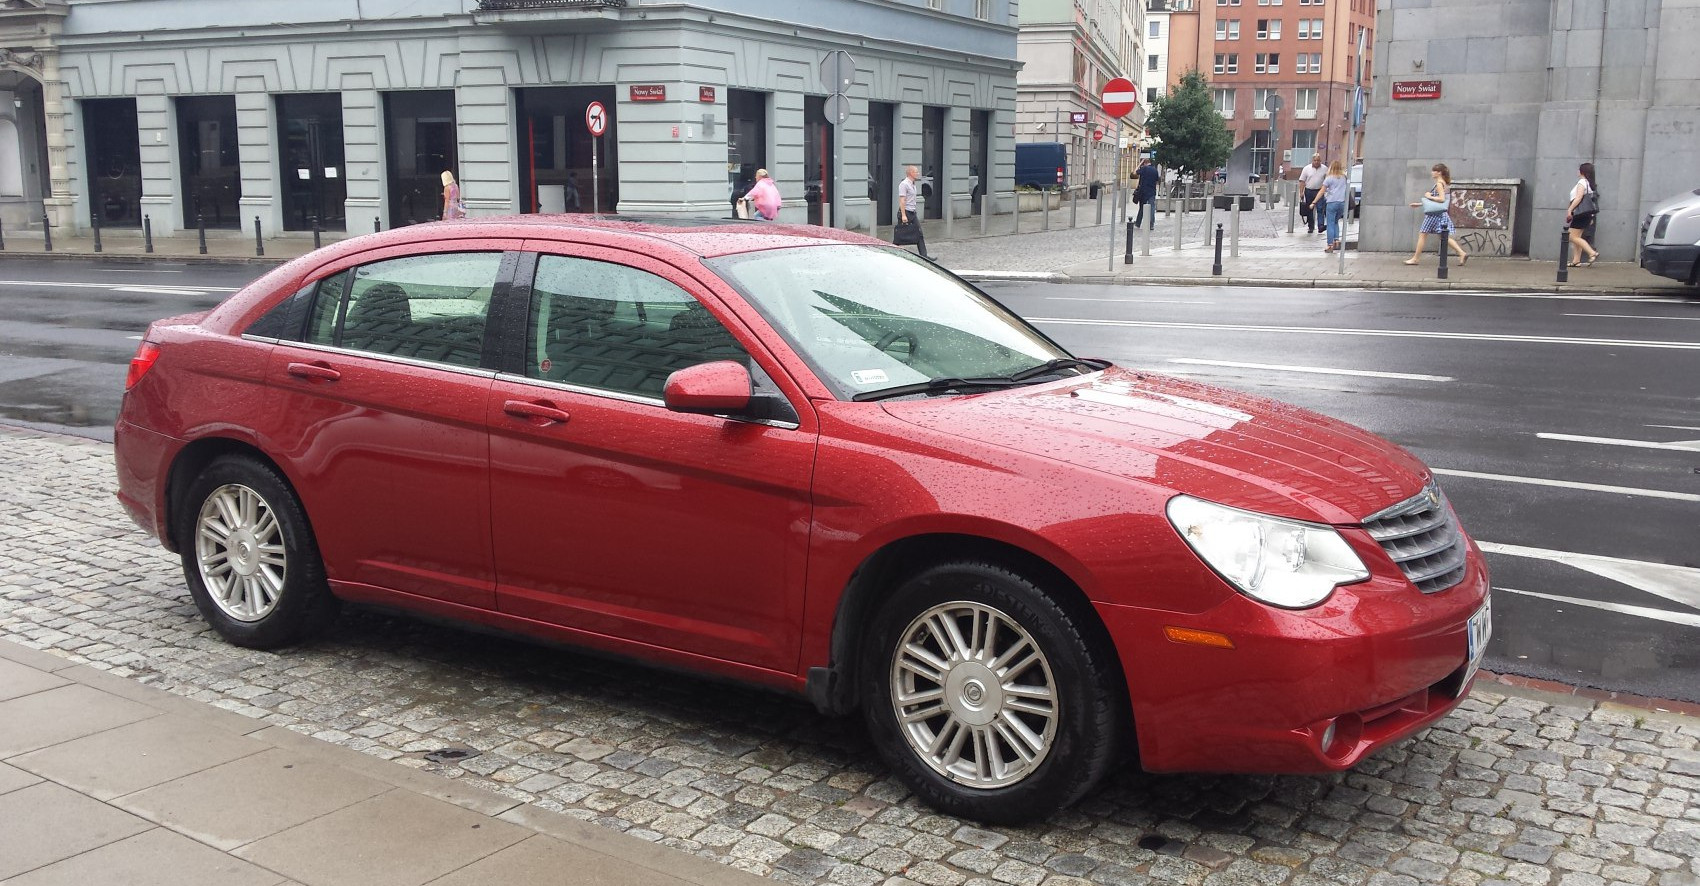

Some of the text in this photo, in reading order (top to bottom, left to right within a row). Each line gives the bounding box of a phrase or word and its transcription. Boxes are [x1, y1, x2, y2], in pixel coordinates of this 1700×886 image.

[634, 88, 648, 96] Nowy
[649, 86, 663, 95] Świat
[1396, 86, 1416, 94] Nowy
[1418, 83, 1436, 92] Świat
